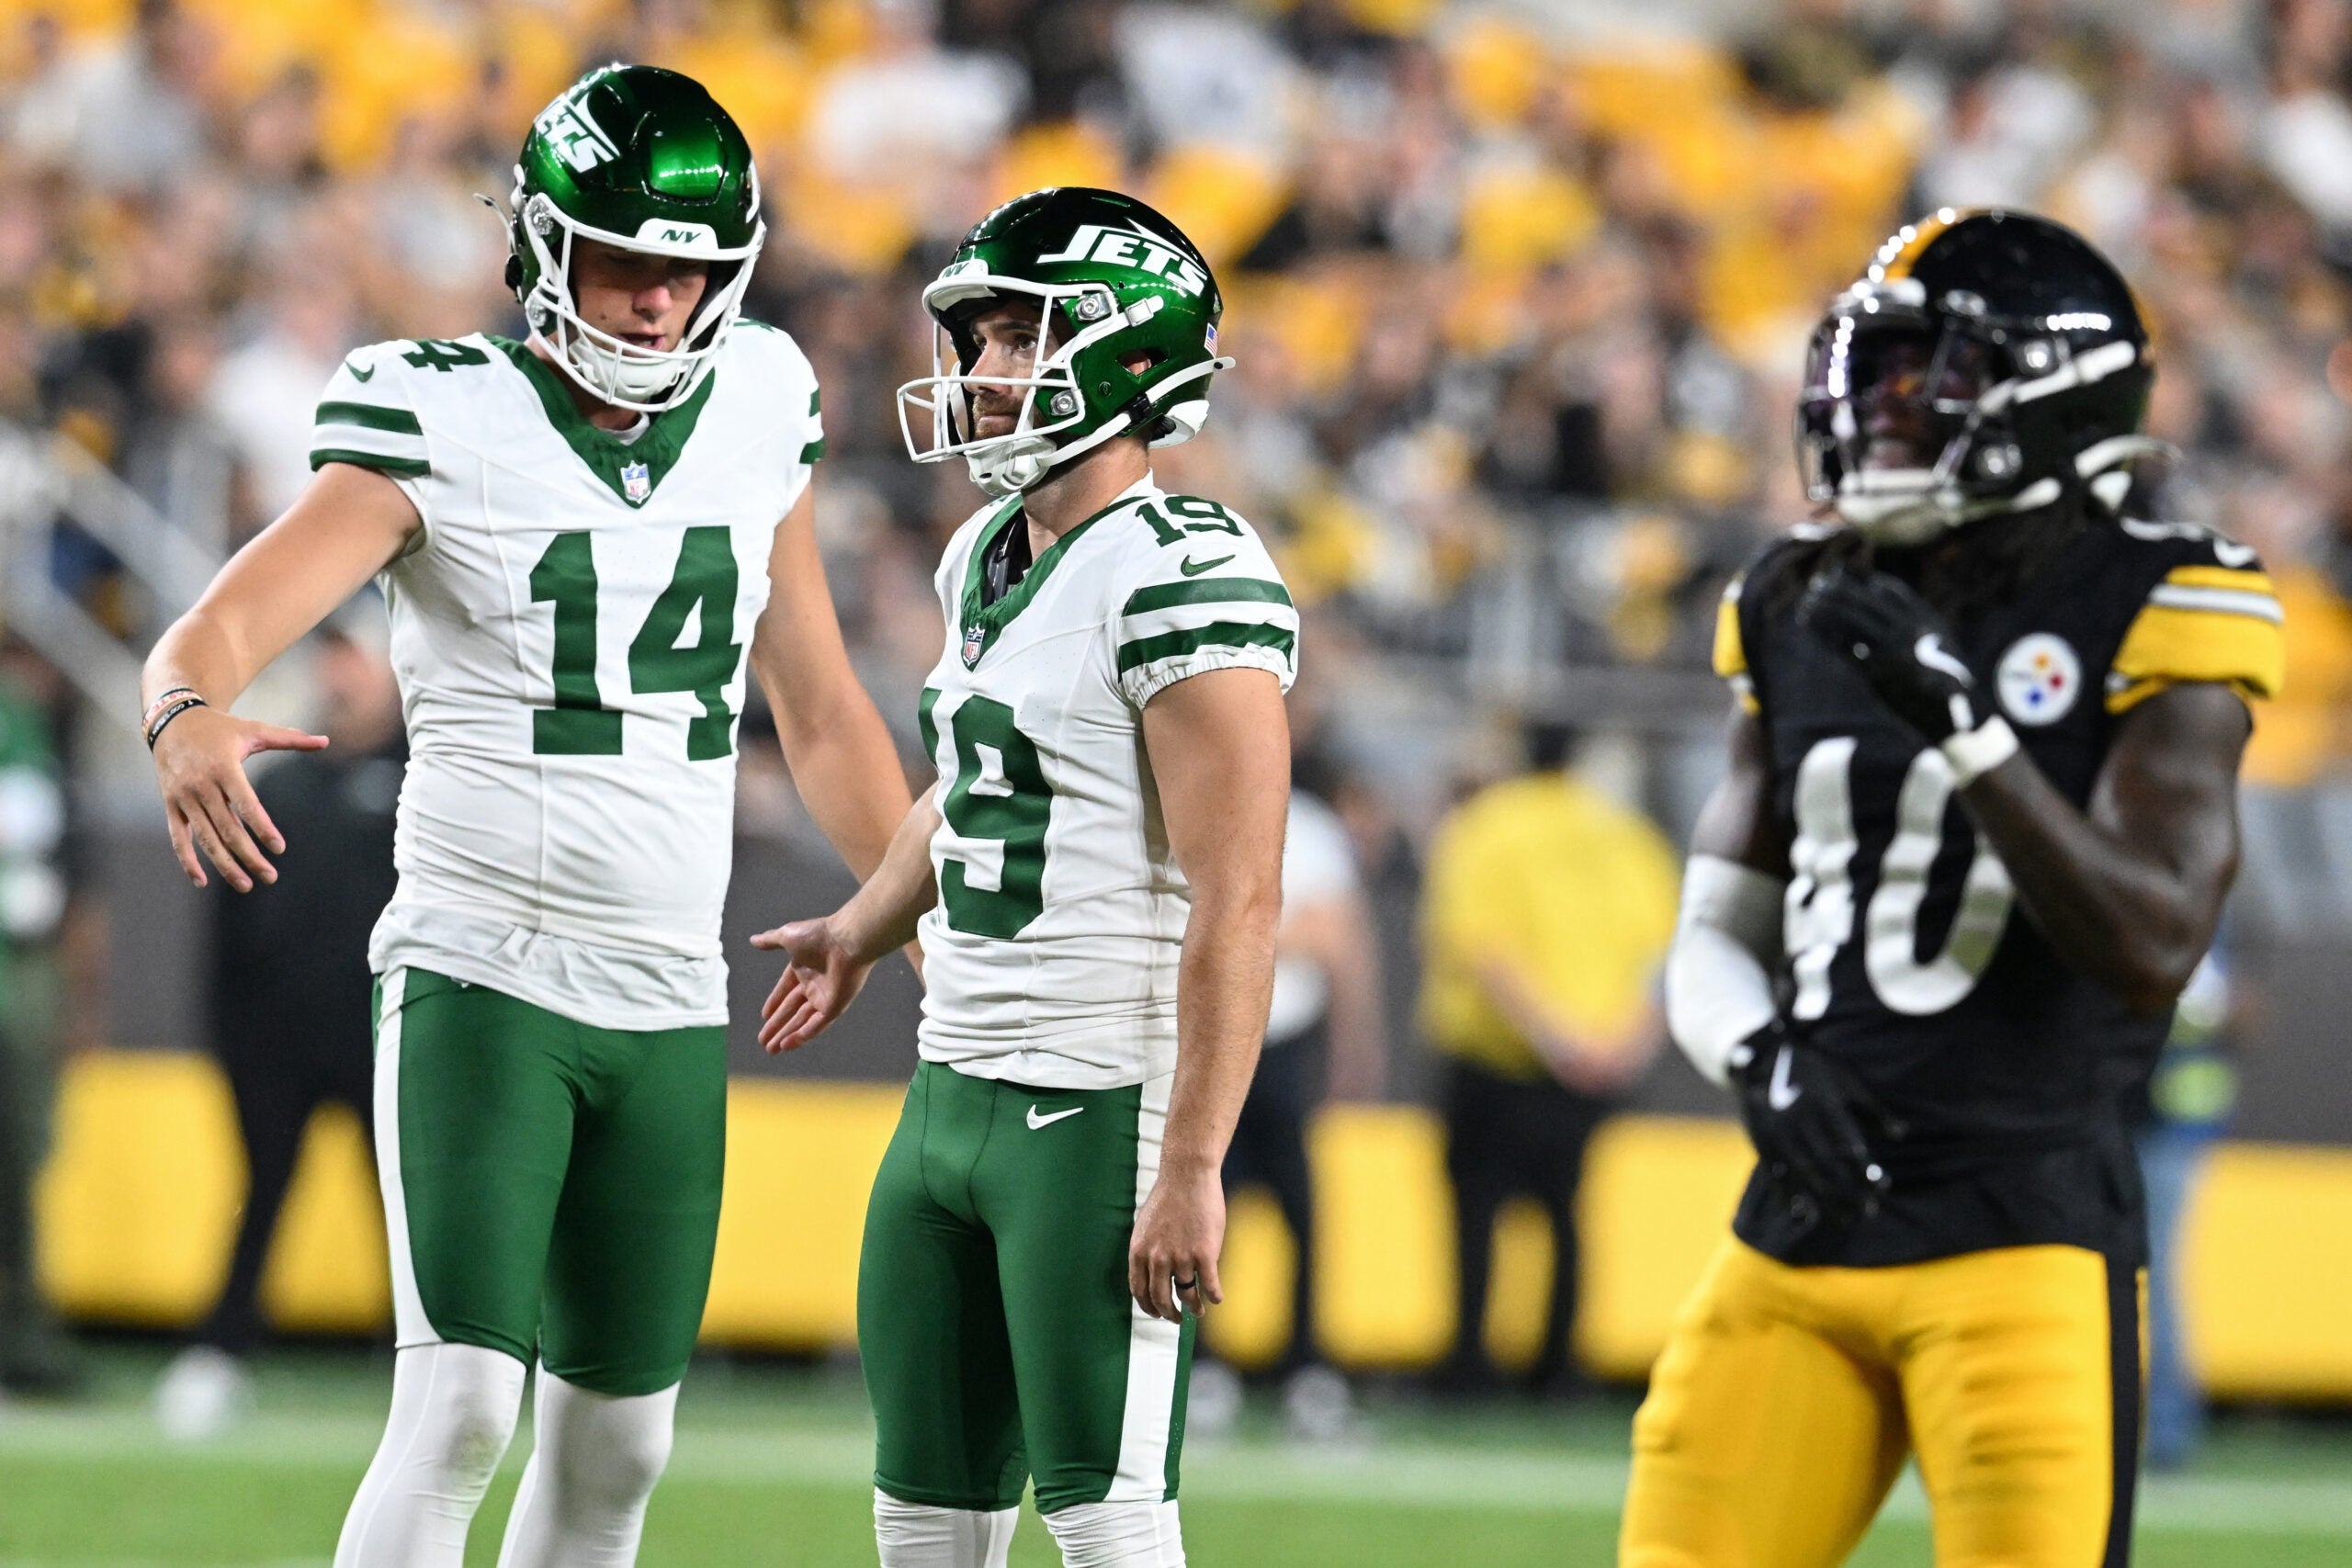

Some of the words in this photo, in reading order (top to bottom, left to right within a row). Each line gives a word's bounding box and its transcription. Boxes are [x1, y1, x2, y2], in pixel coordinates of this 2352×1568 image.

[534, 92, 620, 174] ETS
[661, 229, 702, 243] NY
[1035, 218, 1208, 298] JETS
[1135, 495, 1245, 548] 19
[529, 525, 742, 761] 14
